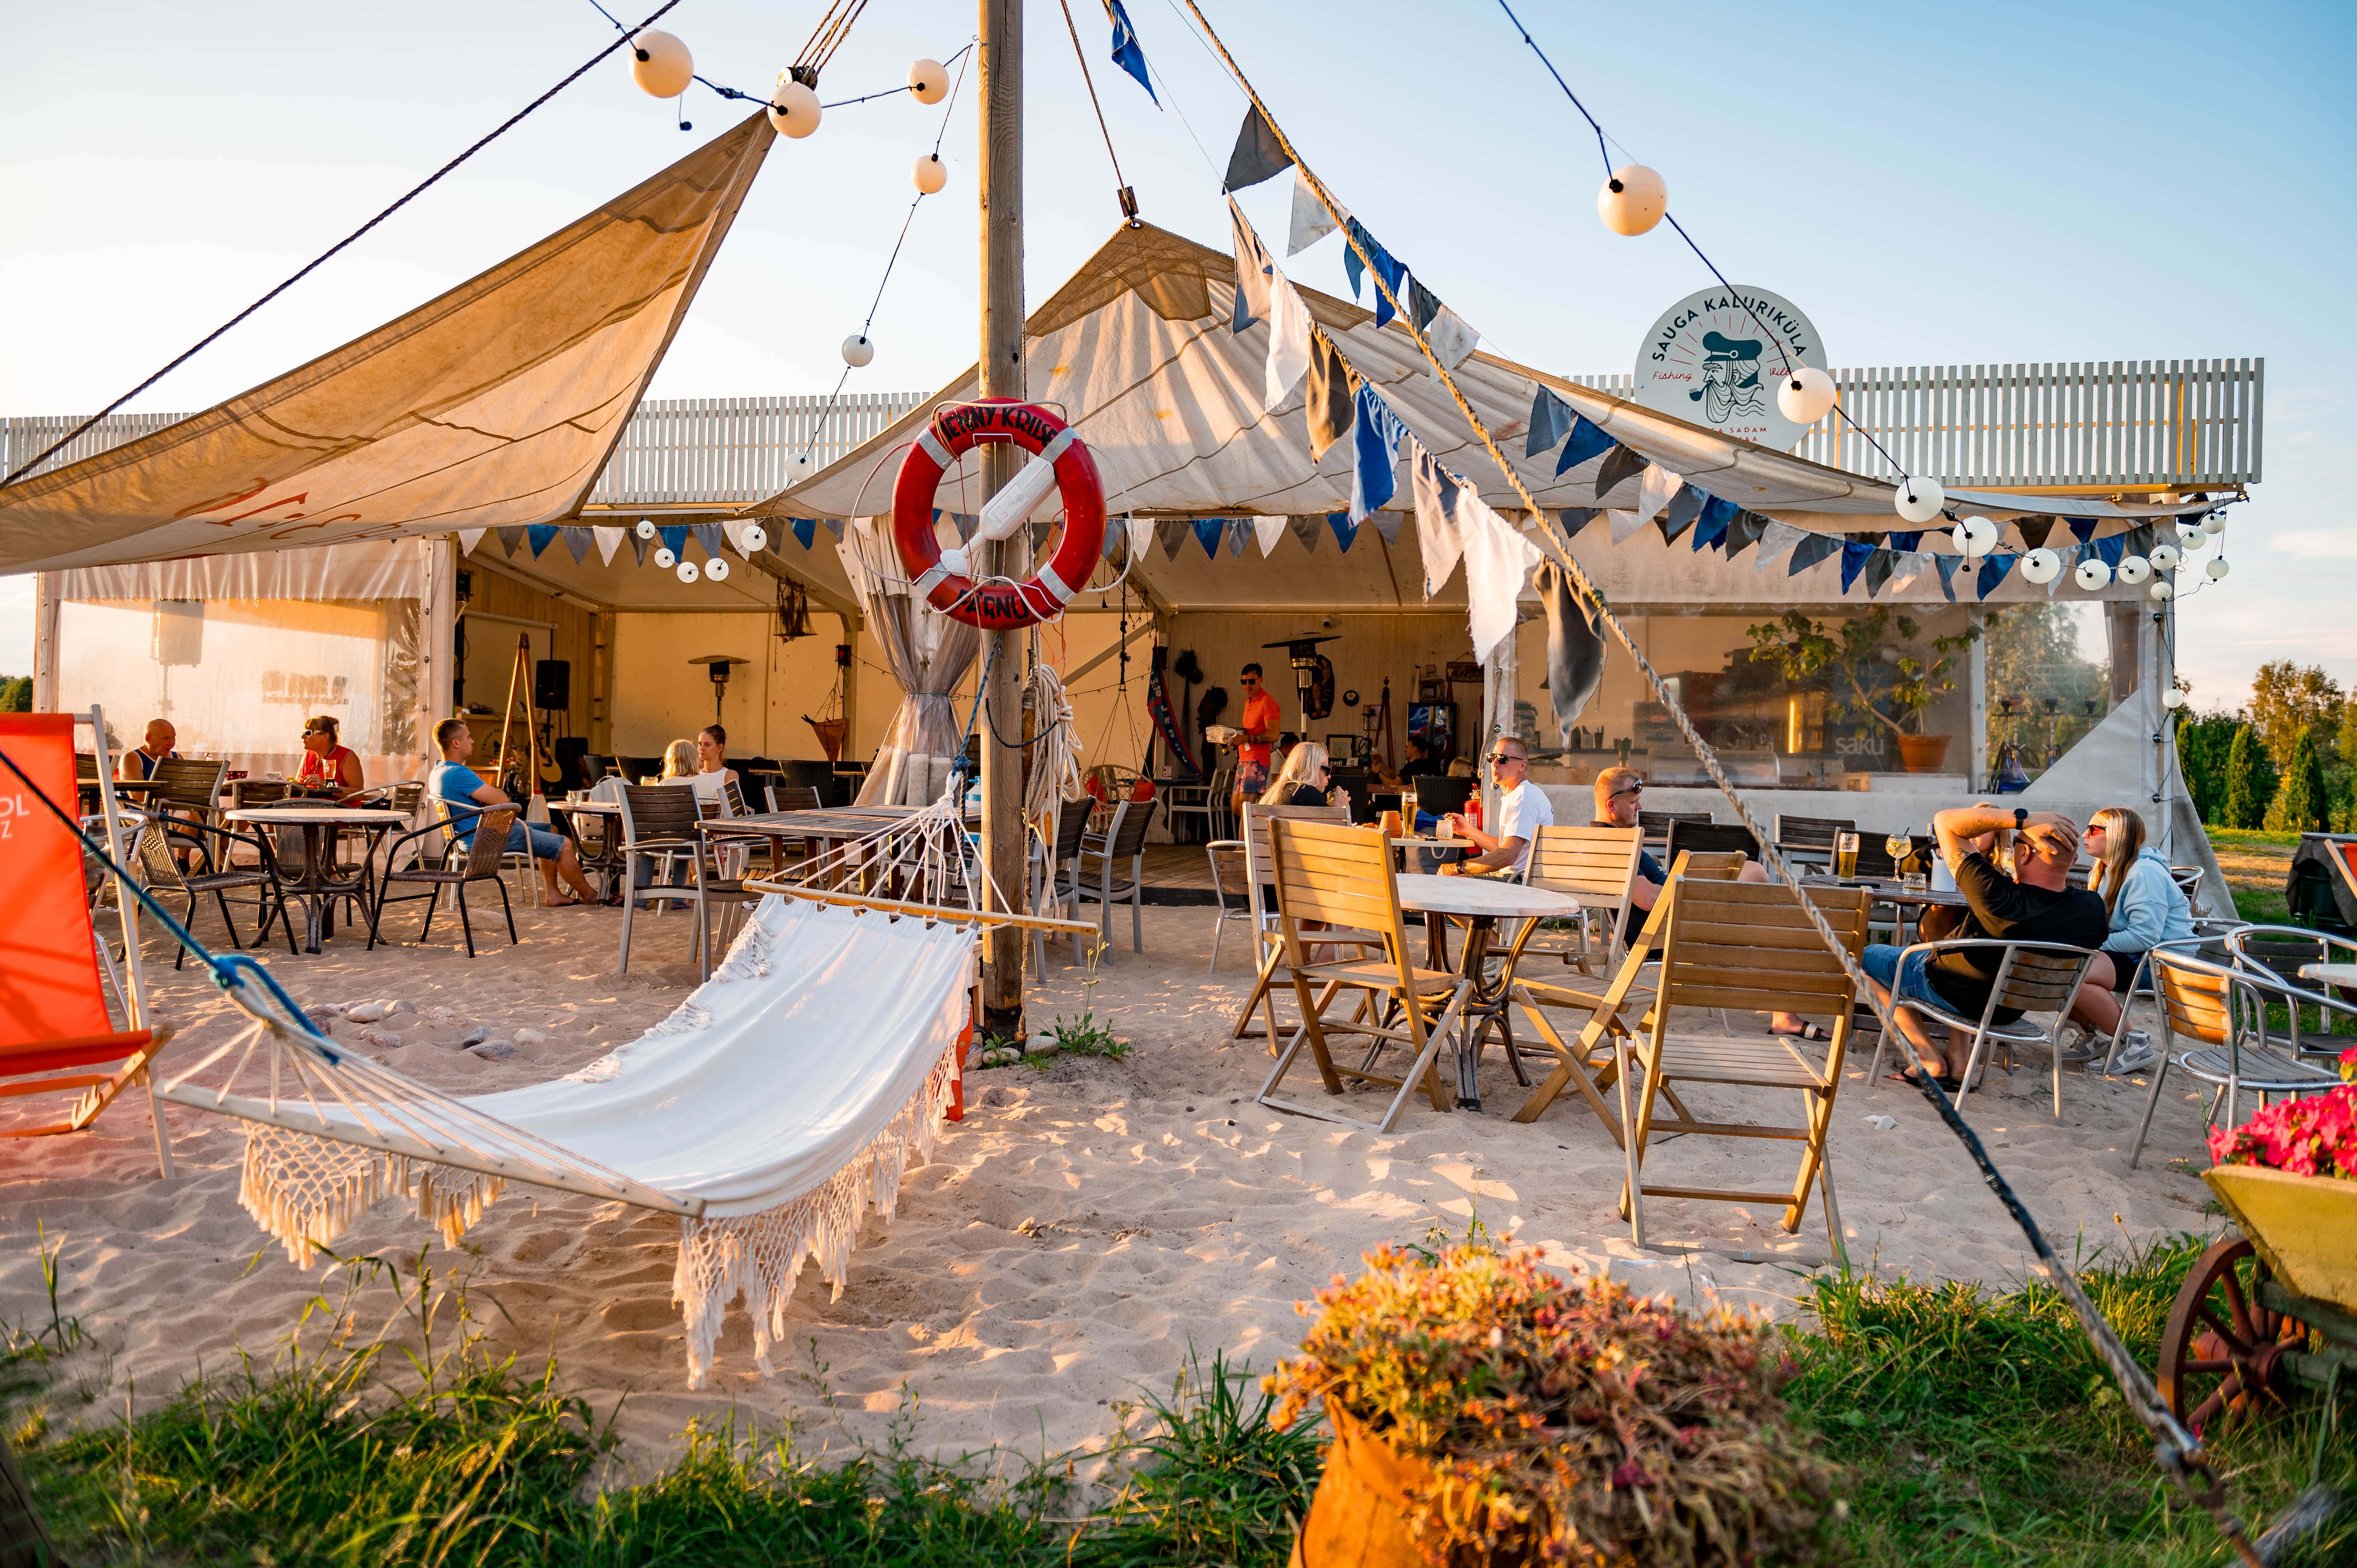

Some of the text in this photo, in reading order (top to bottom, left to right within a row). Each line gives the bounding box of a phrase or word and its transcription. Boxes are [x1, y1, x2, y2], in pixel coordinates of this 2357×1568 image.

[1652, 296, 1807, 362] SAUGA KALURIKÜLA
[1652, 371, 1693, 382] Fishing
[937, 407, 996, 442] JENNY
[1835, 737, 1884, 756] saku
